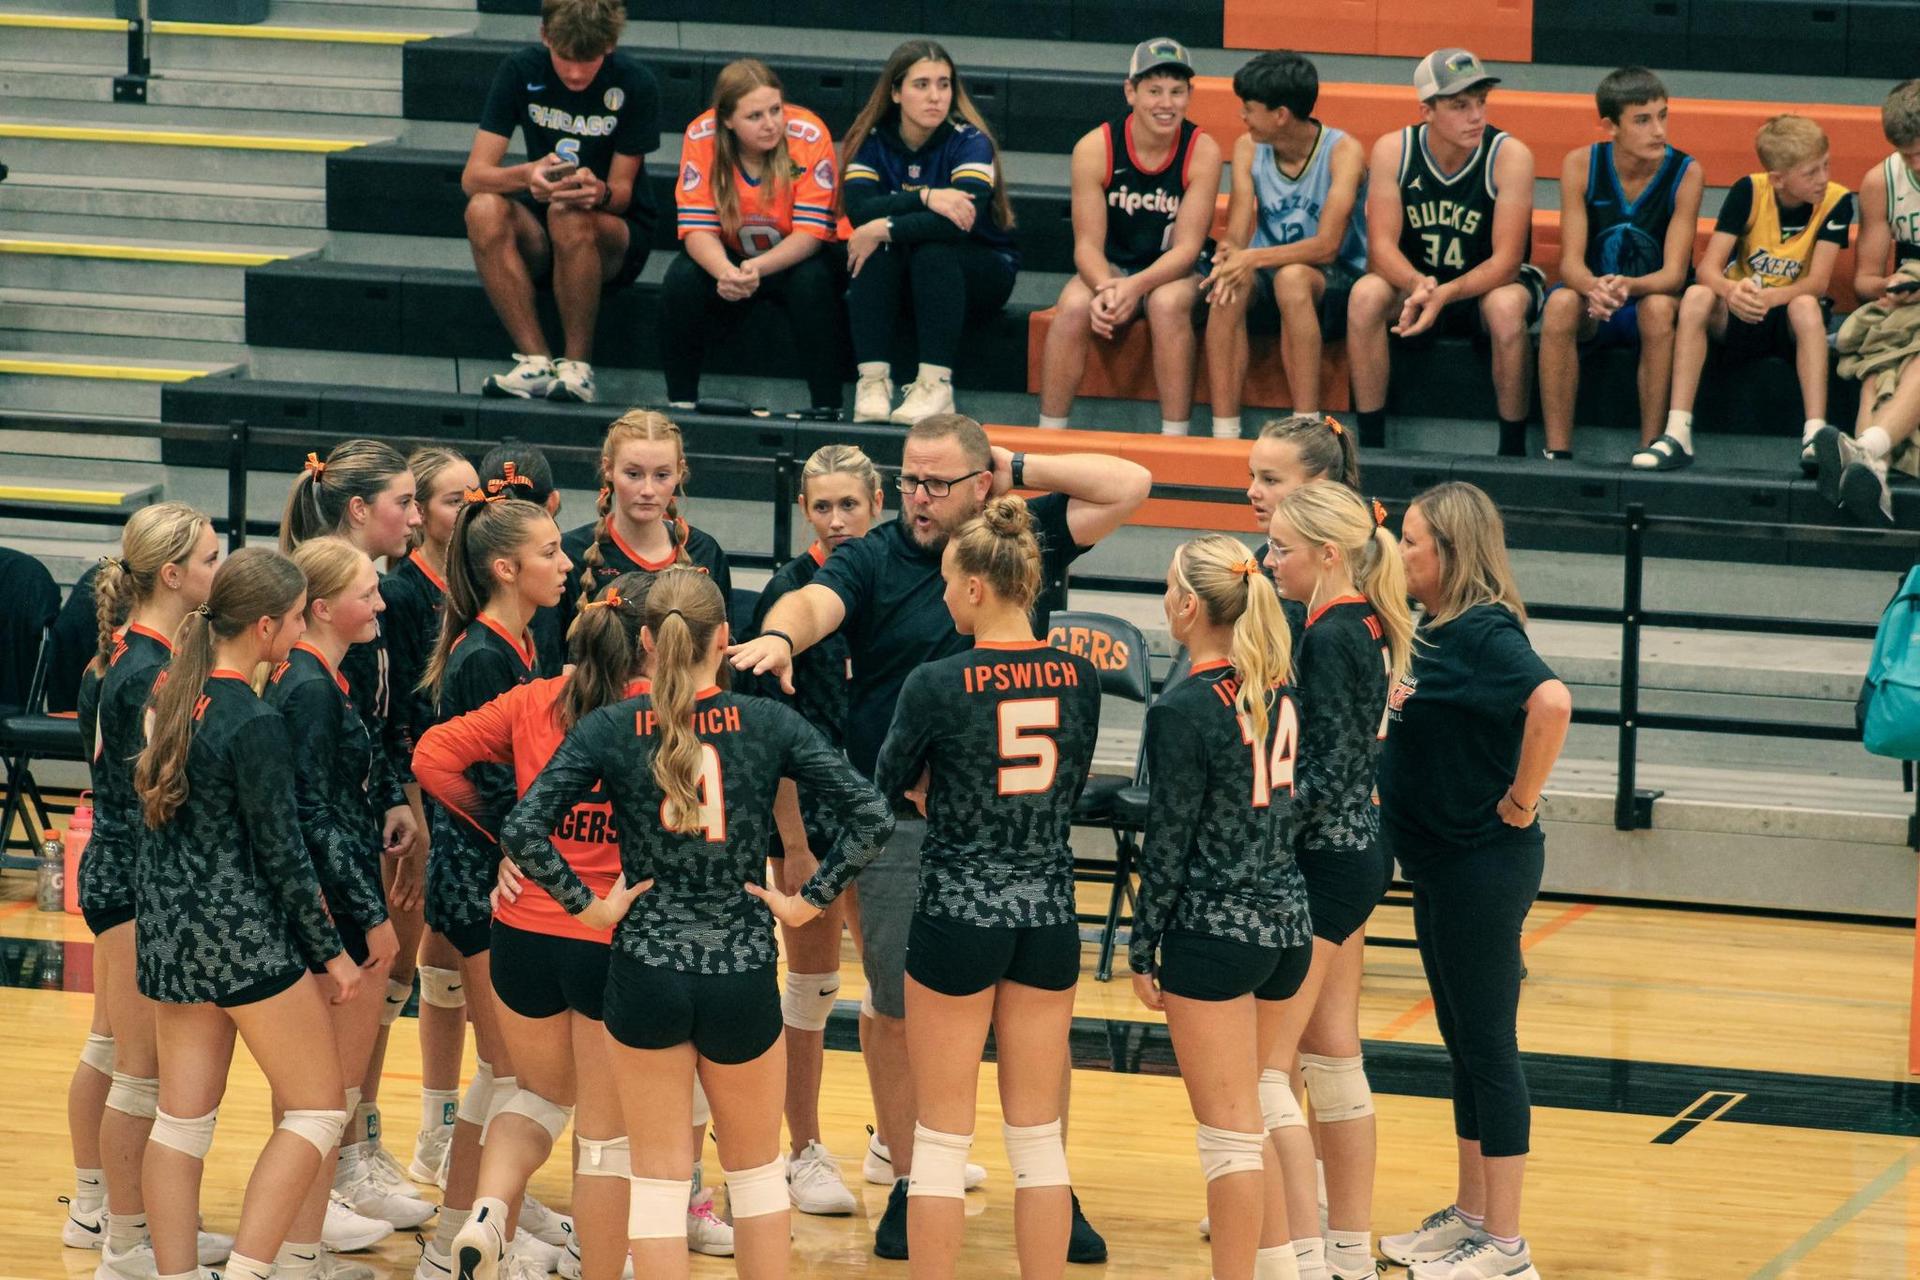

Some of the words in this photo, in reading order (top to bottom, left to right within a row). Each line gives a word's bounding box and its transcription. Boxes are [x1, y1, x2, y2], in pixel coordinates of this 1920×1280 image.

[528, 103, 618, 136] CHICAGO
[1108, 185, 1180, 219] ripcity
[1406, 200, 1482, 235] BUCKS
[1421, 233, 1465, 269] 34
[1747, 247, 1804, 281] LAKERS
[1046, 626, 1129, 671] GERS
[963, 661, 1078, 693] IPSWICH
[635, 705, 741, 737] IPICH
[997, 697, 1059, 796] 5
[555, 810, 619, 844] GERS
